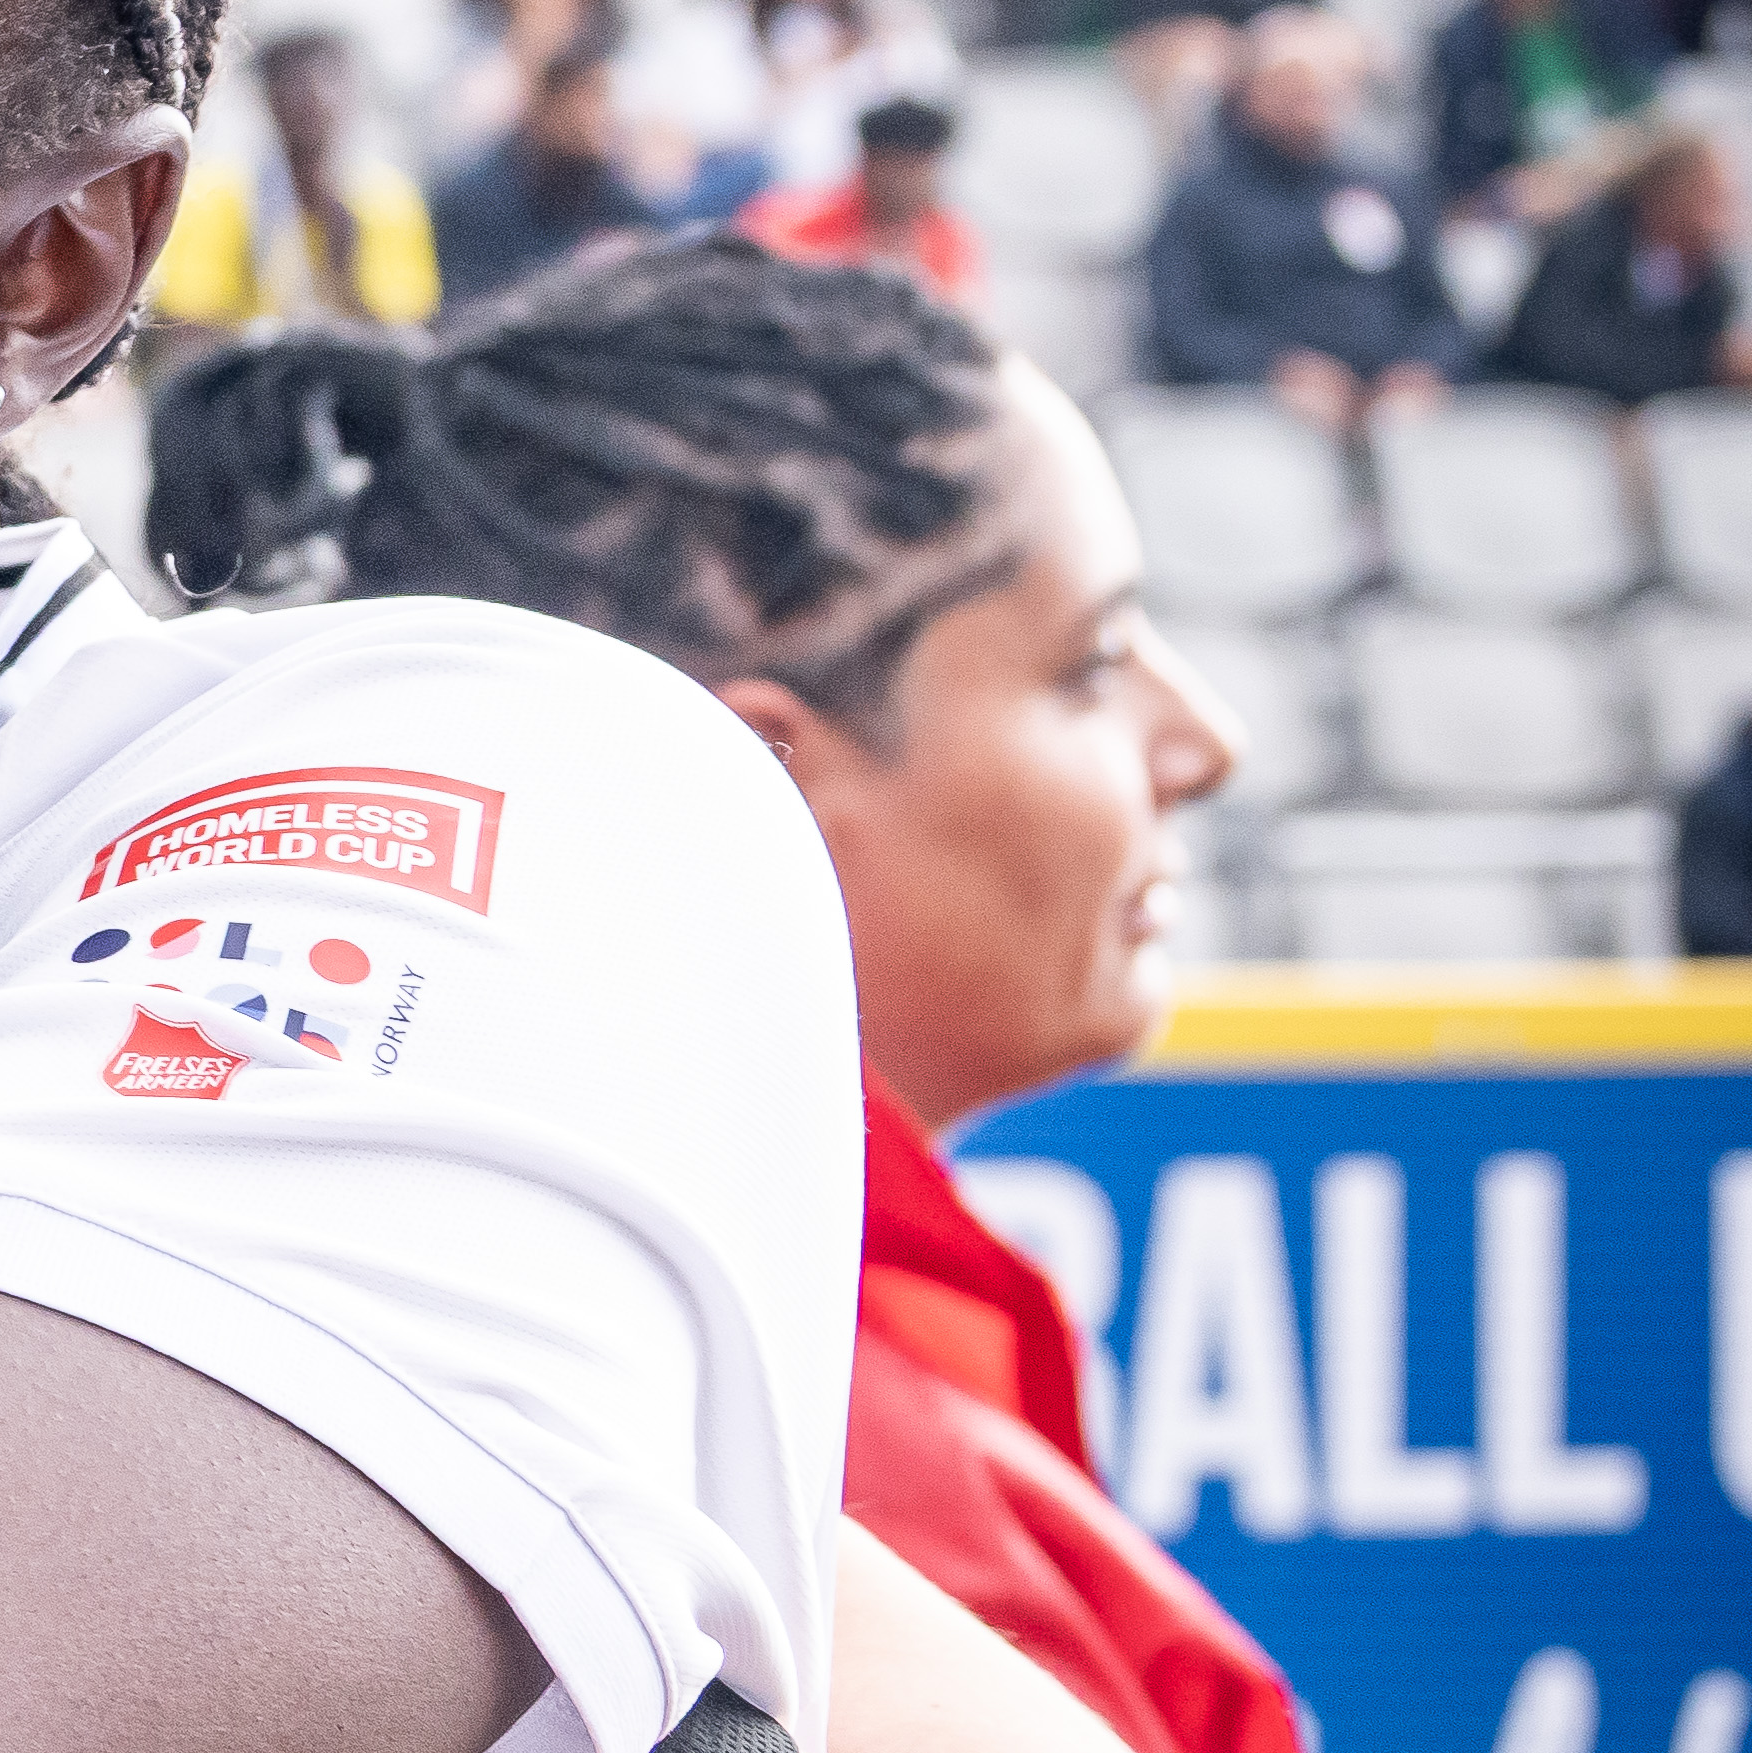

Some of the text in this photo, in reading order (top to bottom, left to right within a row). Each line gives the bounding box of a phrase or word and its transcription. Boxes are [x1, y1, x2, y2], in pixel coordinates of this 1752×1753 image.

[147, 802, 430, 859] HOMELESS
[135, 832, 437, 882] WORLD CUP
[114, 1074, 225, 1090] ARMEEN
